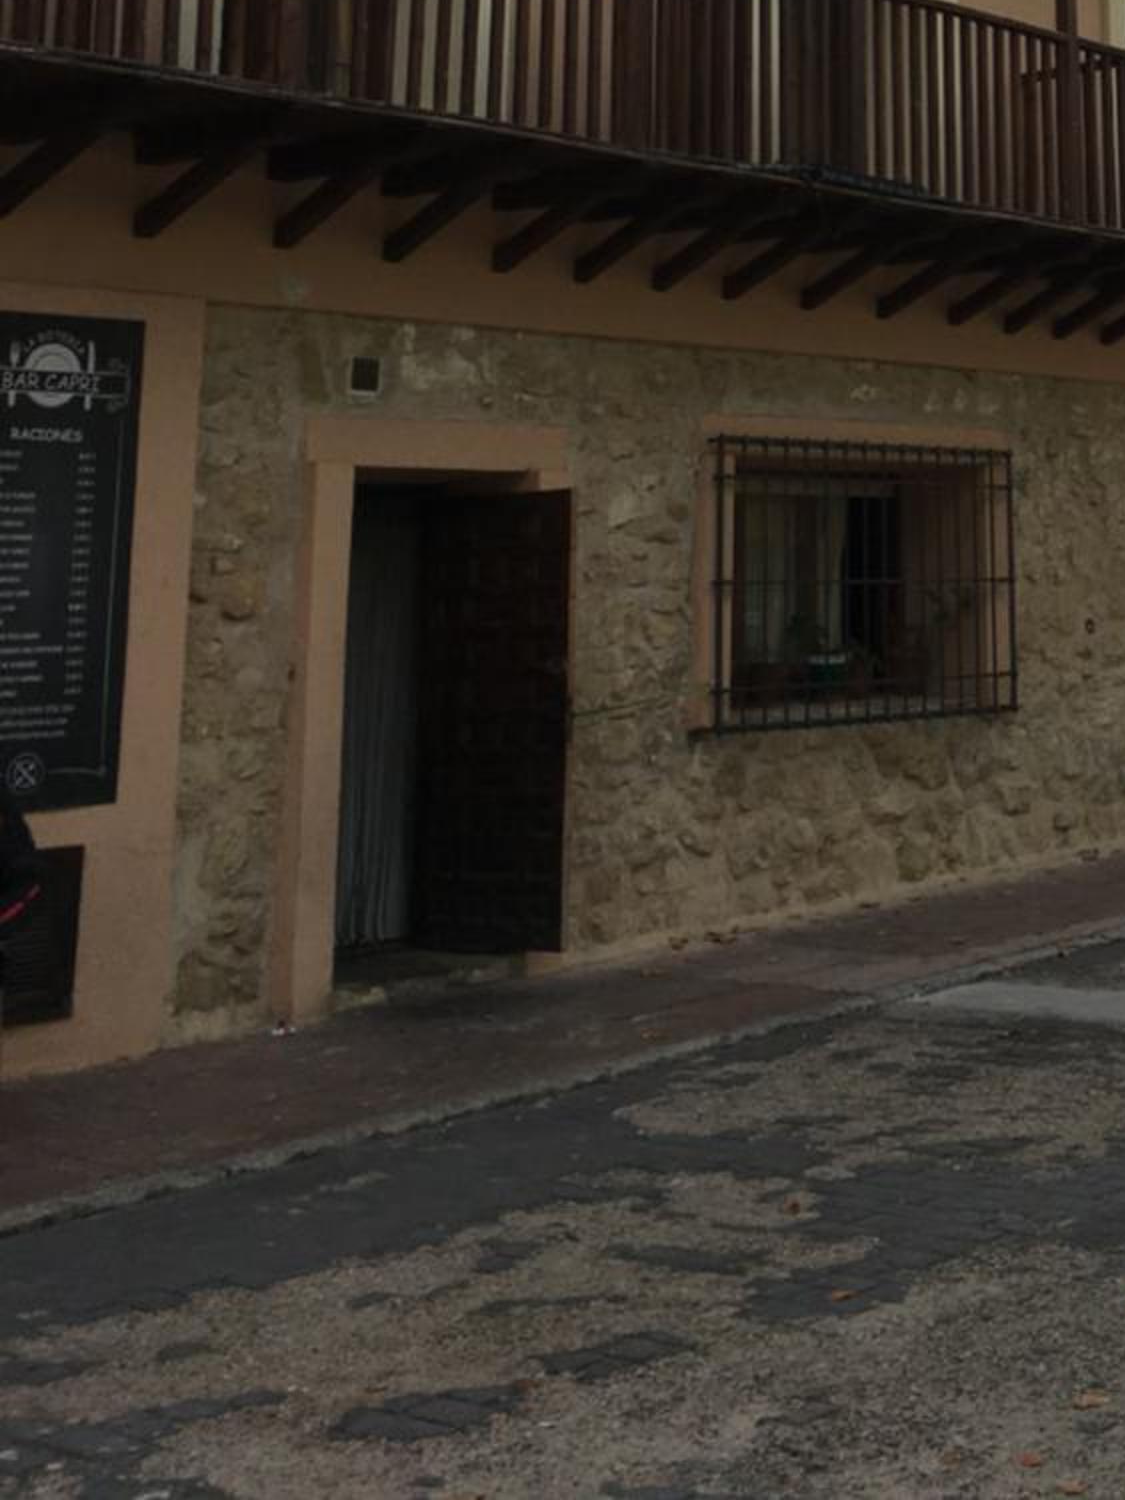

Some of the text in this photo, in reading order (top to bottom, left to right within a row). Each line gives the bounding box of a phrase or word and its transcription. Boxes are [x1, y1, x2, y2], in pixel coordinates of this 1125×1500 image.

[2, 370, 101, 393] BAR CAPRI
[10, 426, 84, 443] RACIONES
